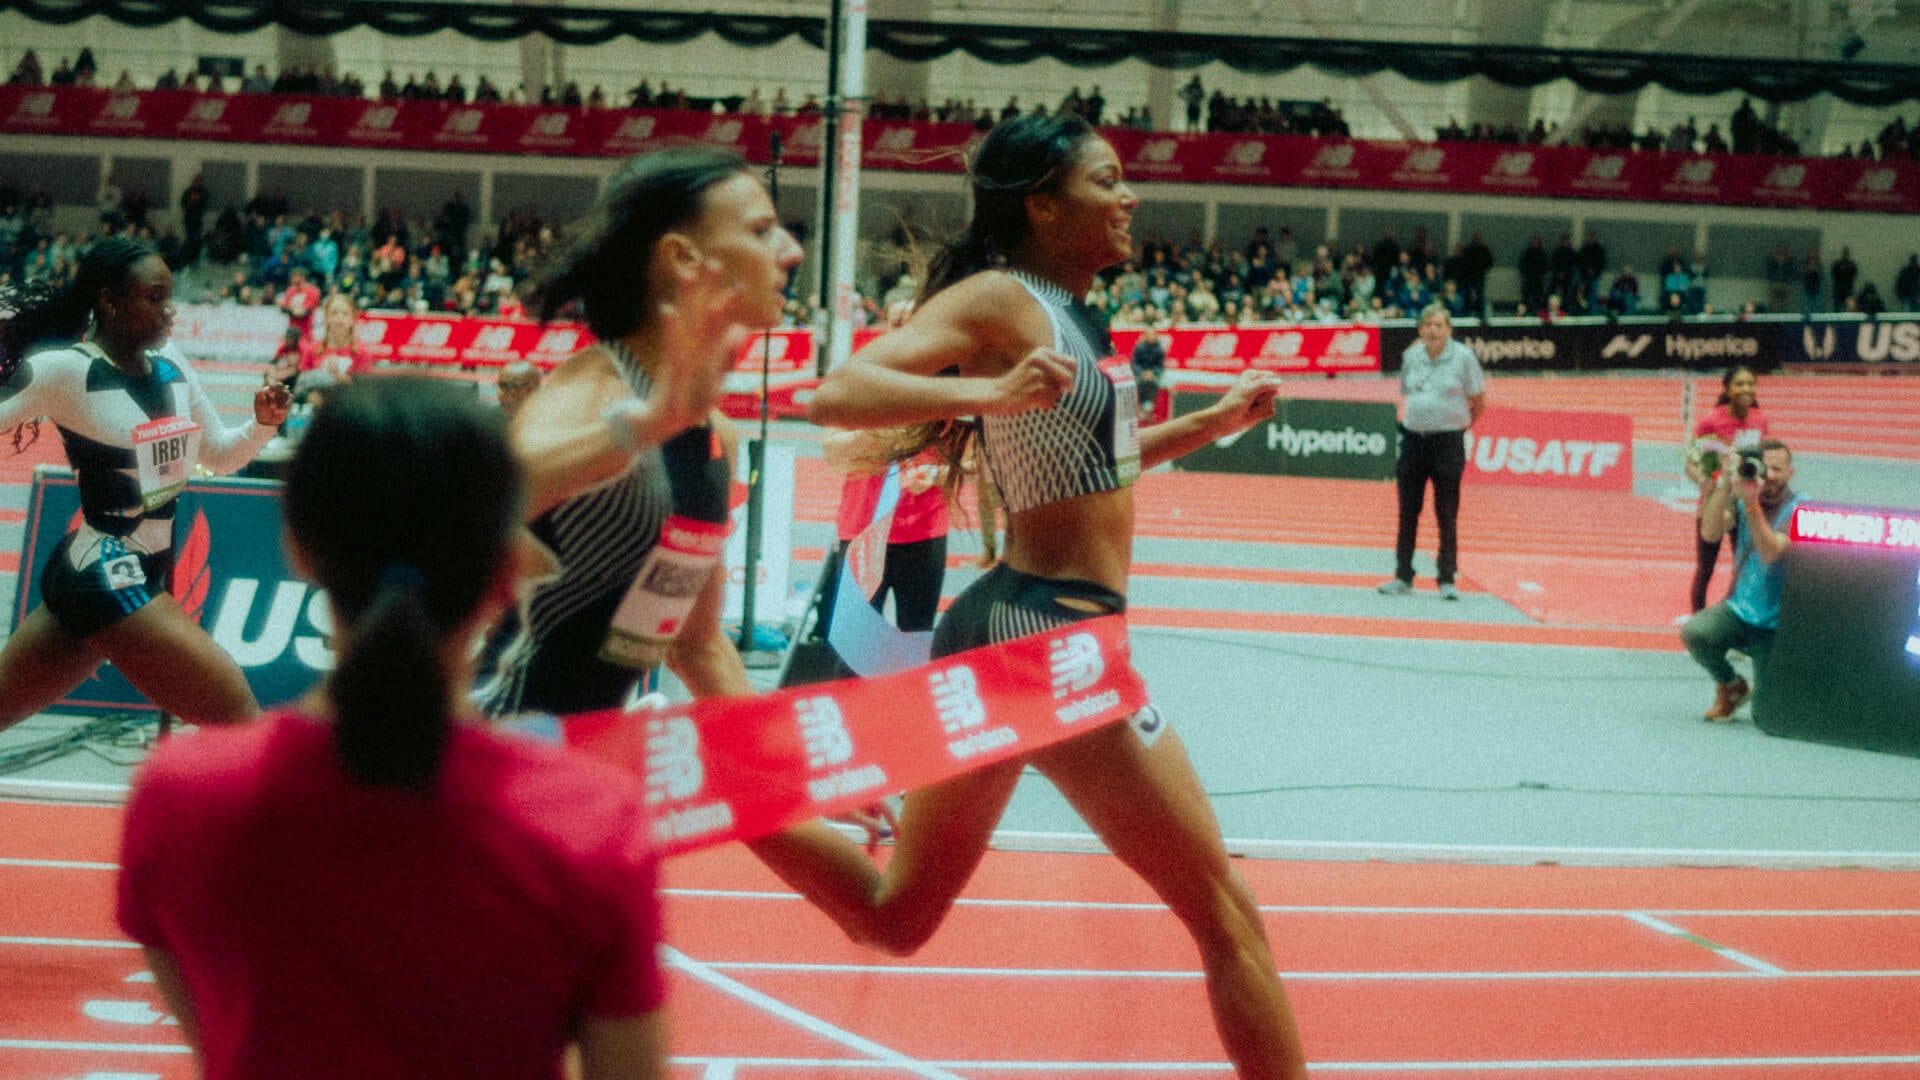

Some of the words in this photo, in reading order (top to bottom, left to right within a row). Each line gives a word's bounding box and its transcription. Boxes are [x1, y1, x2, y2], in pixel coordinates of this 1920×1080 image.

[1665, 334, 1759, 360] Hyperice
[152, 434, 188, 466] IRBY
[1267, 423, 1387, 457] Hyperice
[1475, 437, 1622, 477] USATF
[1797, 509, 1884, 544] WOMEN
